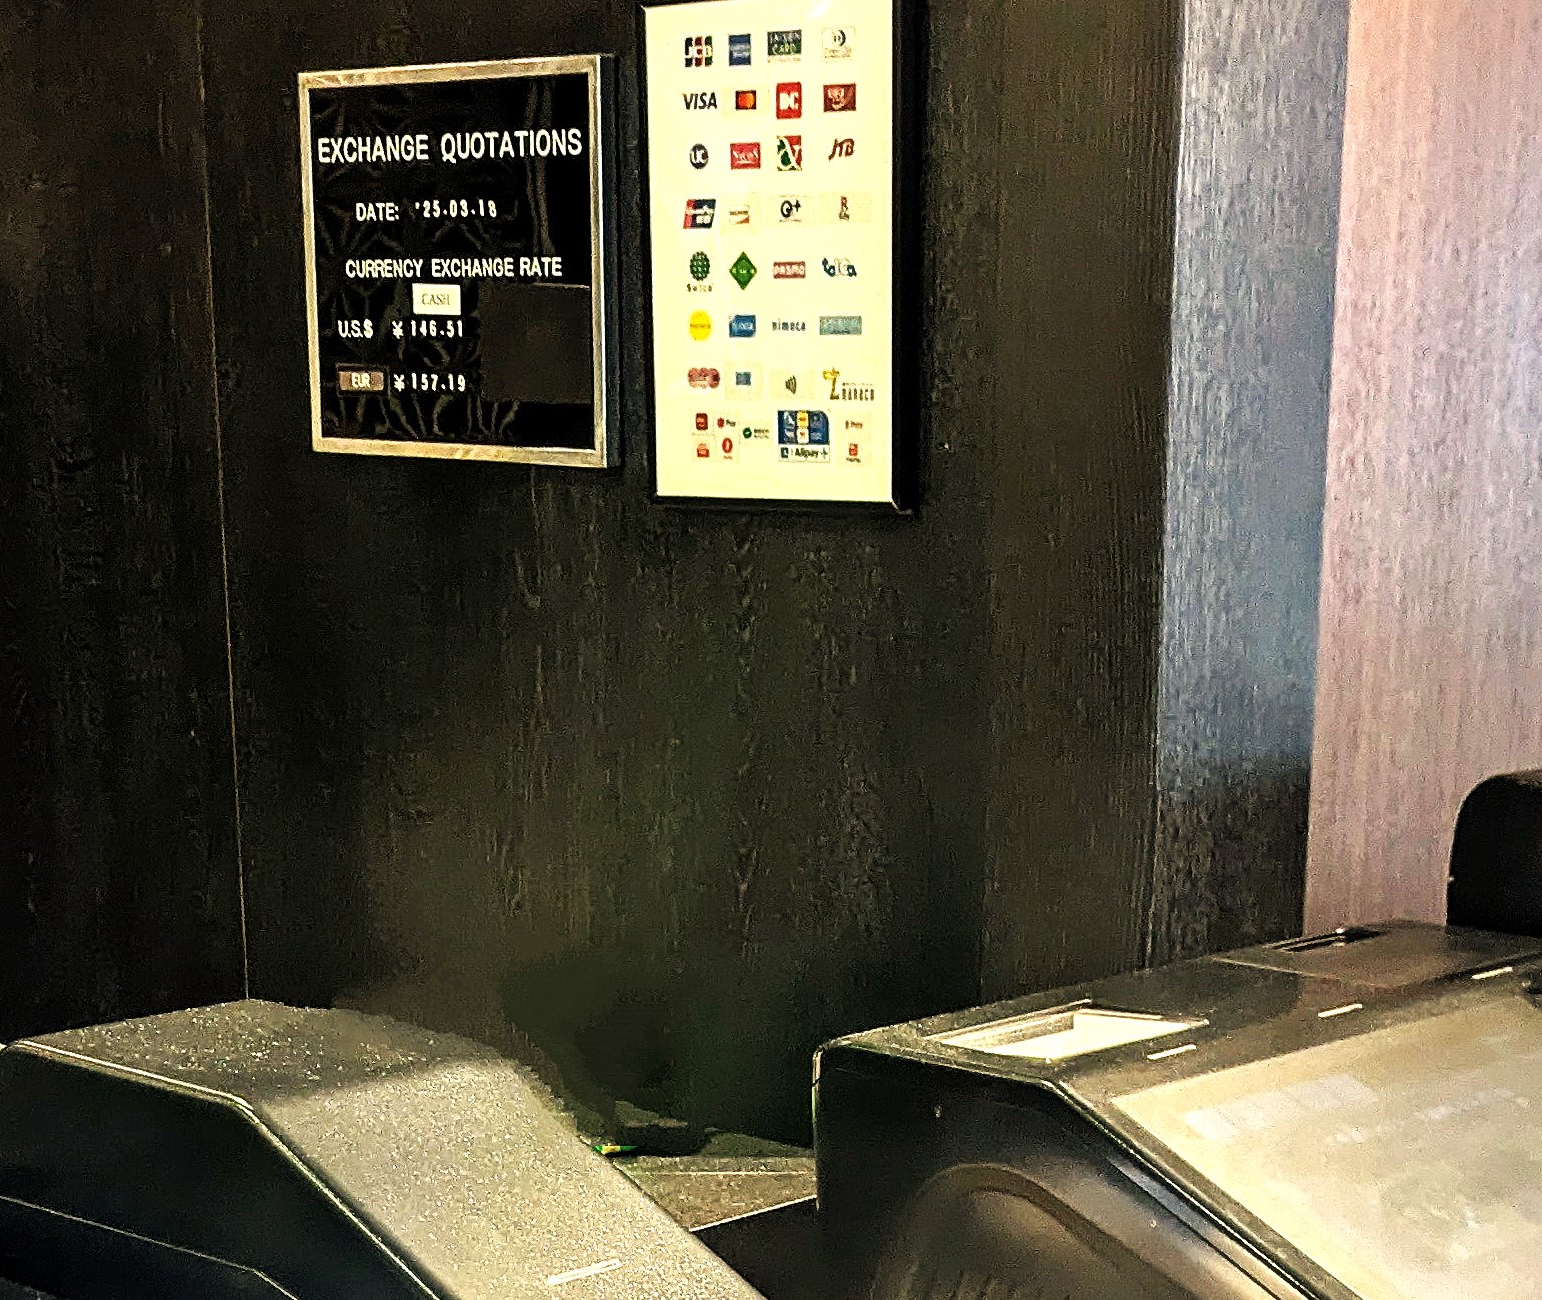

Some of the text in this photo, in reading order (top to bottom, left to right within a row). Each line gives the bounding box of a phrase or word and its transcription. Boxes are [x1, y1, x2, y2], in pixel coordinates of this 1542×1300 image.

[683, 92, 718, 110] VISA
[317, 129, 582, 163] EXCHANGE QUOTATIONS
[828, 137, 855, 162] JTB
[355, 202, 399, 222] DATE:
[345, 256, 563, 279] CURRENCY EXCHANGE RATE
[421, 293, 450, 306] CASH
